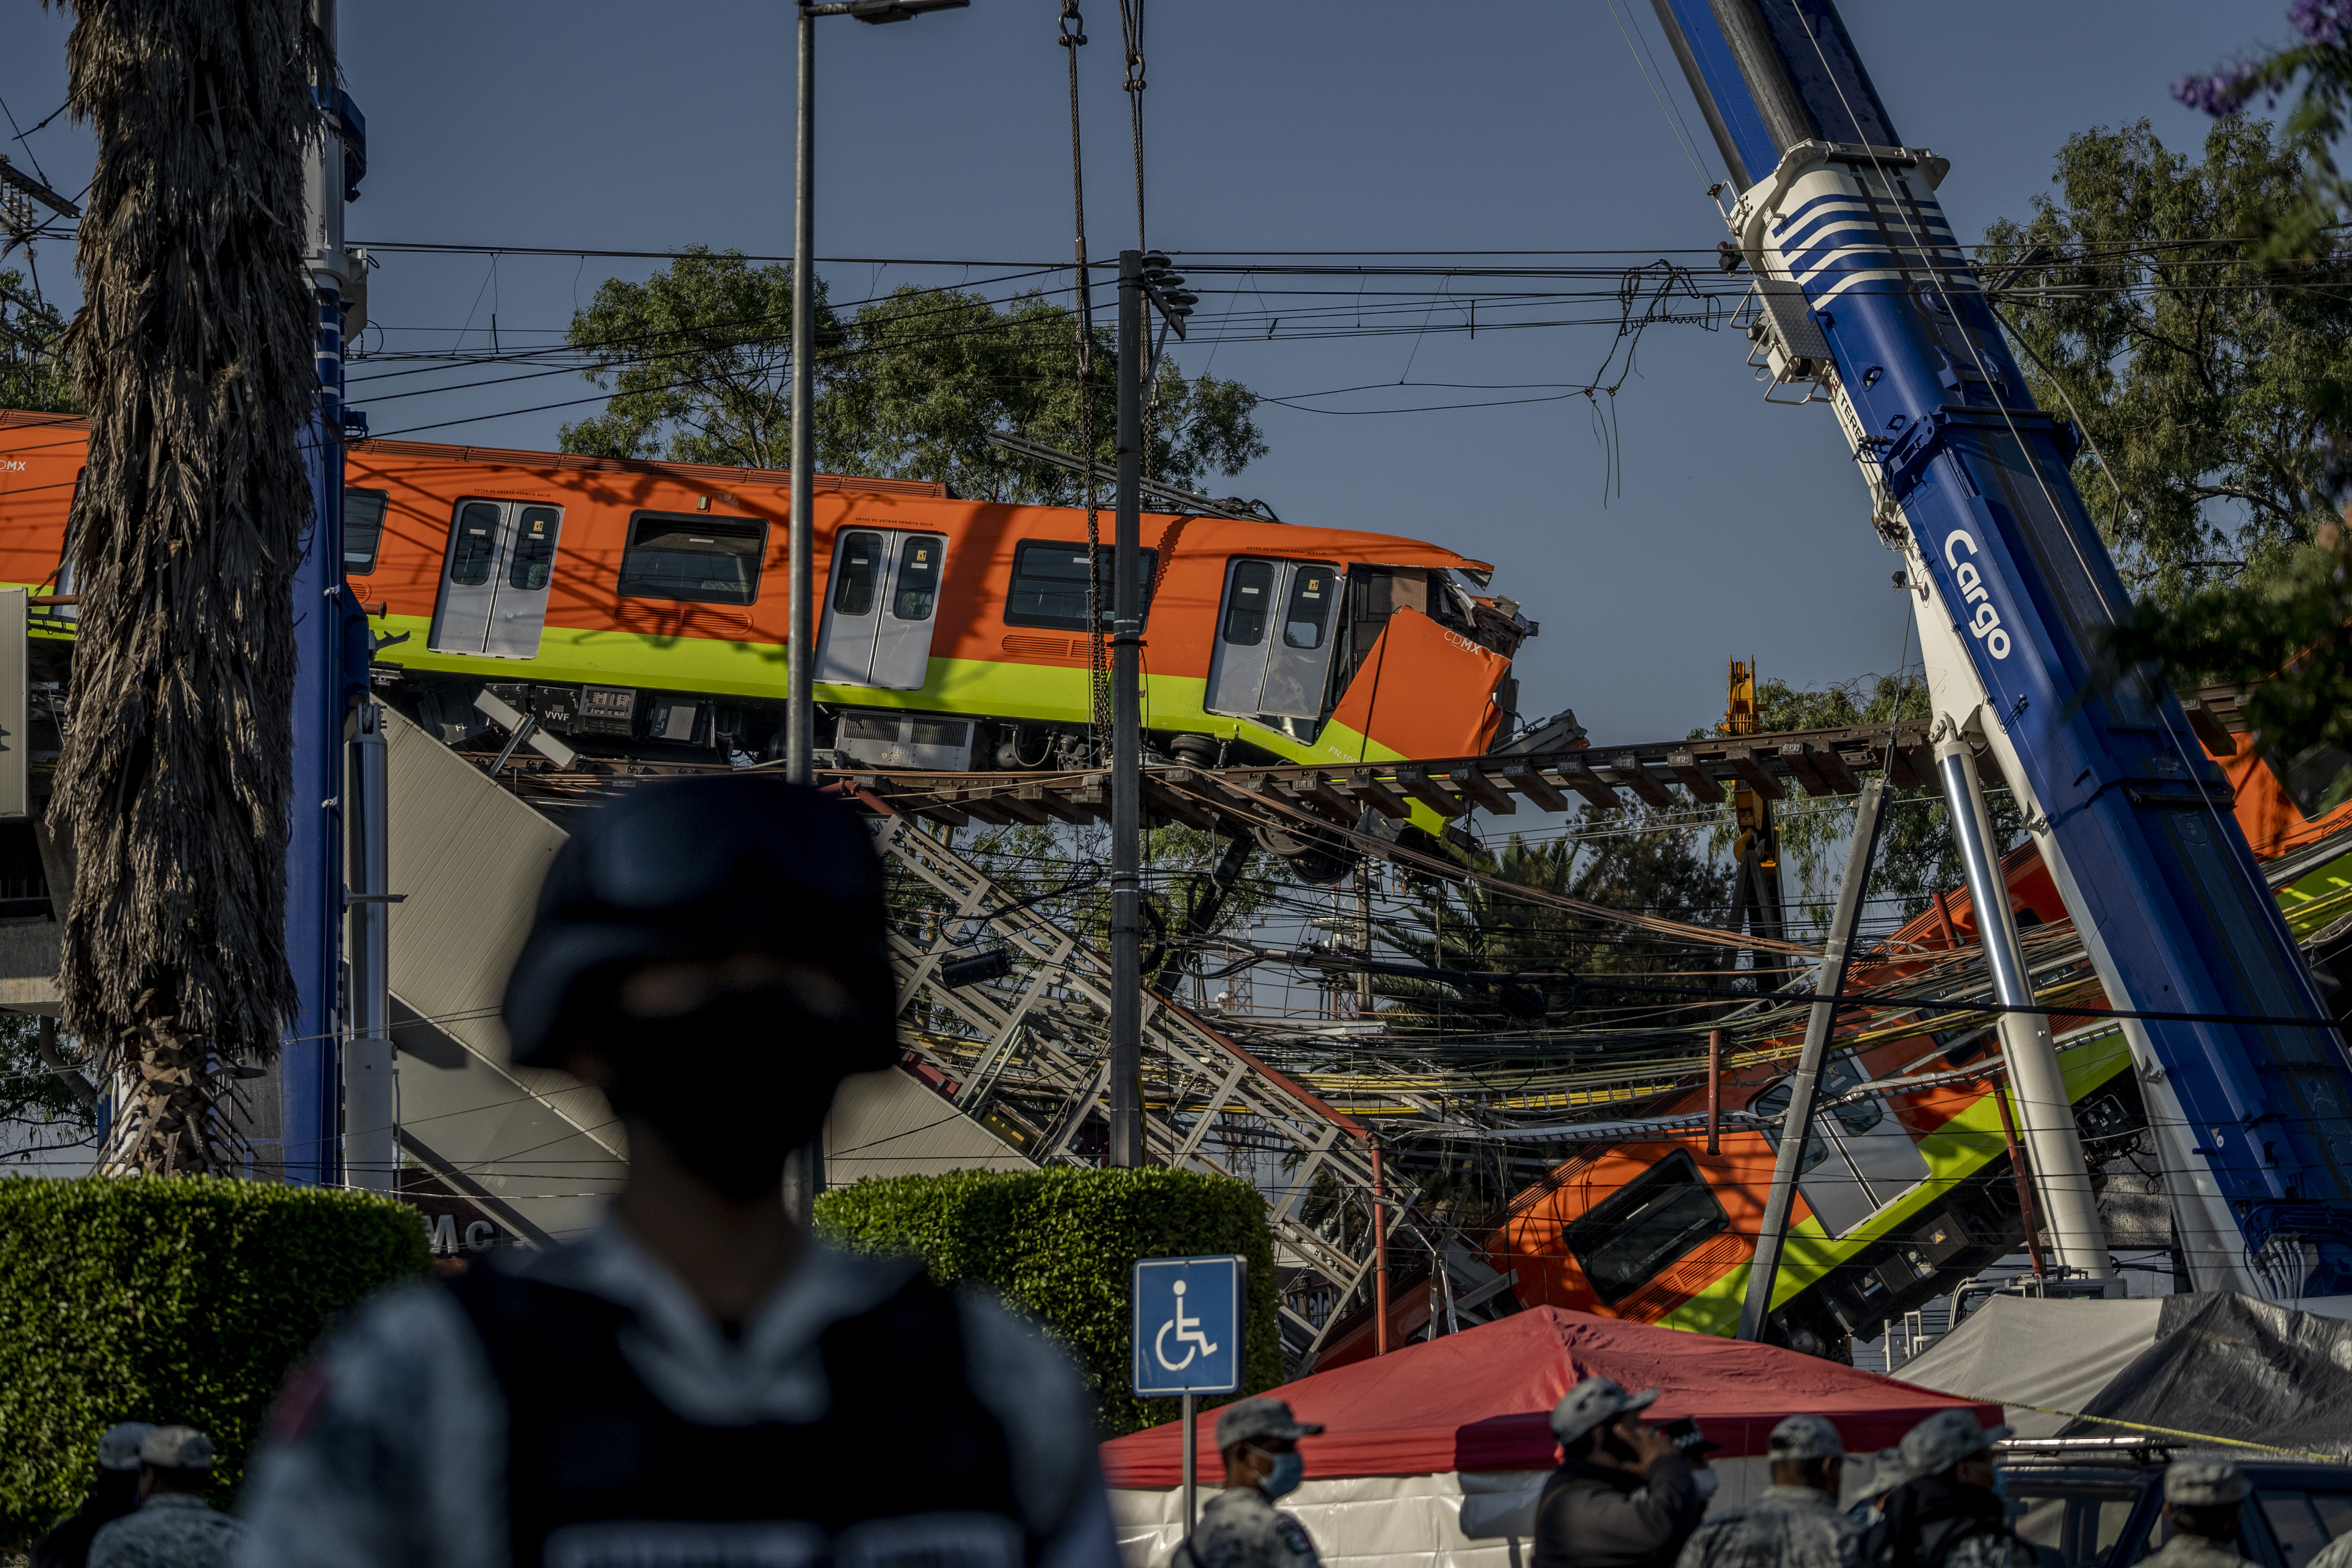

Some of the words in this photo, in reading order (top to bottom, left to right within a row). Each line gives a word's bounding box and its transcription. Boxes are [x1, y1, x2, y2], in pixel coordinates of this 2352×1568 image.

[1841, 392, 1863, 442] TERE
[1945, 529, 2011, 660] Cargo
[1444, 630, 1480, 655] CDMX
[545, 710, 570, 721] VVVF
[455, 722, 467, 732] FL
[1329, 746, 1360, 763] FN.100
